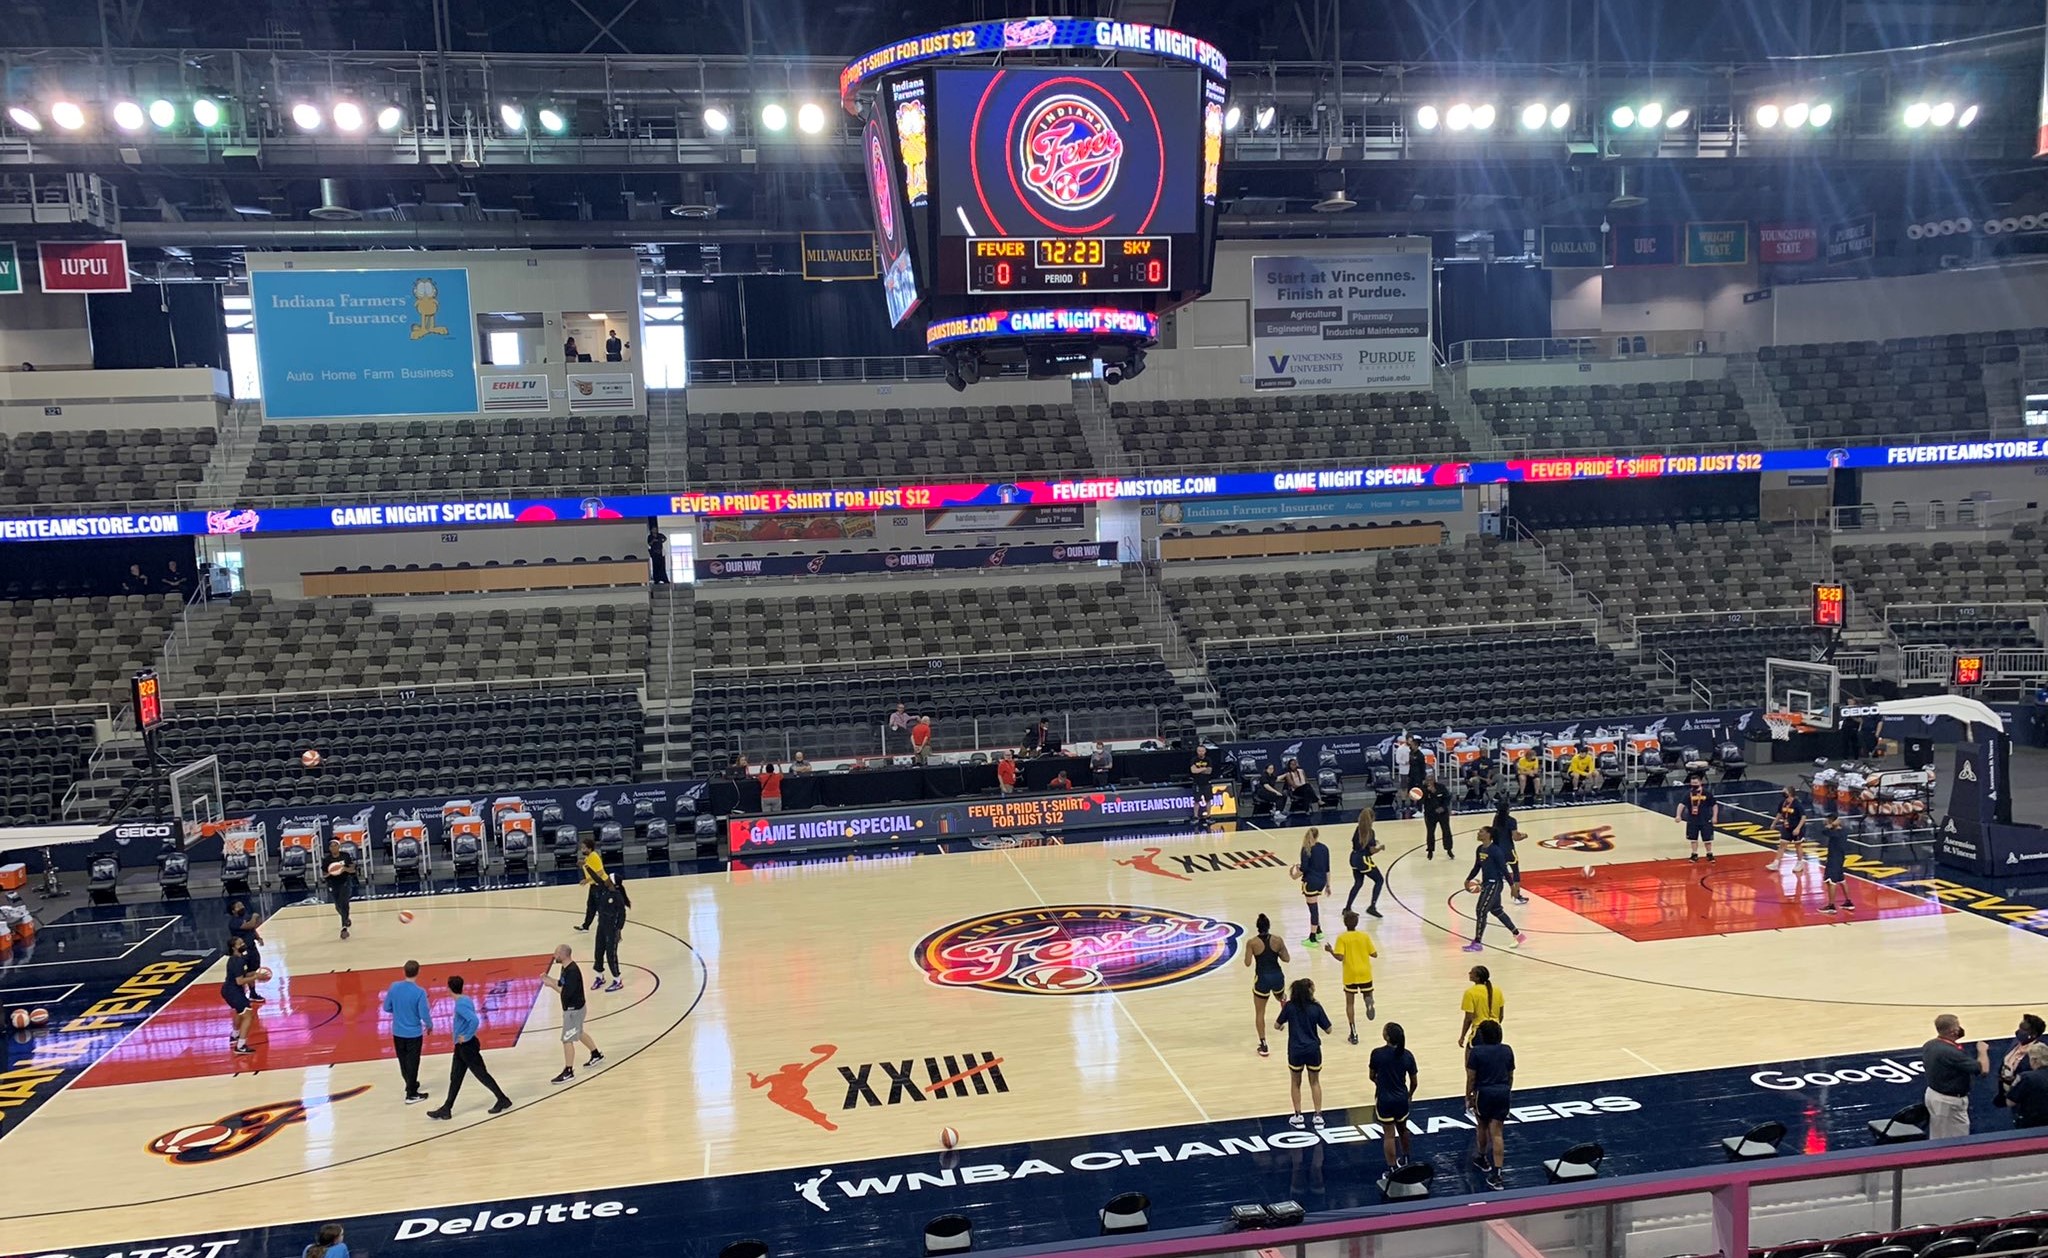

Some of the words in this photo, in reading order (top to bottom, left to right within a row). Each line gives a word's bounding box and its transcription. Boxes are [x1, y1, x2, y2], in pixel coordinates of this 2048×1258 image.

[1096, 21, 1152, 50] GAME
[1153, 27, 1199, 61] NIGHT
[863, 46, 896, 73] T-SHIRT
[897, 41, 920, 61] FOR
[920, 33, 952, 56] JUST
[892, 78, 924, 94] Indiana
[1040, 106, 1103, 132] INDIANA
[1028, 122, 1123, 187] Fever
[1760, 229, 1817, 241] YOUNGSTOWN
[977, 241, 1025, 257] FEVER
[1123, 241, 1151, 255] SKY
[1551, 241, 1597, 253] OAKLAND
[1776, 242, 1802, 254] STATE
[806, 249, 873, 262] MILWAUKEE
[60, 258, 109, 275] IUPUI
[1148, 261, 1161, 282] 0
[997, 263, 1012, 285] 0
[1045, 274, 1073, 284] PERIOD
[1267, 272, 1306, 284] Start
[1310, 272, 1326, 283] at
[1331, 270, 1416, 283] Vincennes.
[1277, 287, 1323, 300] Finish
[1328, 287, 1344, 299] at
[1348, 286, 1406, 299] Purdue.
[272, 295, 336, 309] Indiana
[339, 293, 407, 309] Farmers
[328, 311, 407, 326] Insurance
[1011, 312, 1055, 331] GAME
[1057, 311, 1102, 329] NIGHT
[1104, 312, 1147, 331] SPECIAL
[1290, 310, 1337, 321] Agriculture
[1352, 312, 1393, 323] Pharmacy
[1267, 323, 1318, 334] Engineering
[1326, 326, 1366, 336] Industrial
[1367, 325, 1419, 335] Maintenance
[1291, 352, 1343, 363] VINCENNES
[1359, 350, 1416, 364] PURDUE
[286, 369, 314, 382] Auto
[322, 369, 357, 381] Home
[364, 368, 395, 381] Farm
[401, 366, 454, 379] Business
[1290, 363, 1344, 373] UNIVERSITY
[1366, 374, 1411, 383] purdue.edu
[1531, 462, 1571, 478] FEVER
[1574, 460, 1613, 477] PRIDE
[1615, 458, 1666, 476] T-SHIRT
[1668, 457, 1697, 473] FOR
[1699, 455, 1735, 472] JUST
[1736, 454, 1762, 471] $12
[1274, 472, 1317, 491] GAME
[1318, 470, 1363, 489] NIGHT
[1365, 467, 1425, 486] SPECIAL
[1052, 477, 1217, 500] FEVERTEAMSTORE.COM
[671, 495, 720, 513] FEVER
[724, 493, 769, 511] PRIDE
[772, 492, 832, 510] T-SHIRT
[835, 491, 866, 508] FOR
[867, 489, 903, 506] JUST
[905, 489, 931, 506] $12
[1187, 507, 1230, 517] Indiana
[1232, 505, 1278, 515] Farmers
[1280, 502, 1334, 513] Insurance
[1345, 501, 1363, 510] Auto
[1370, 499, 1393, 508] Home
[1400, 498, 1420, 507] Farm
[331, 508, 383, 526] GAME
[386, 504, 439, 524] NIGHT
[442, 502, 514, 522] SPECIAL
[1142, 508, 1155, 516] 201
[893, 517, 908, 527] 200
[900, 555, 917, 565] OUR
[917, 553, 935, 564] WAY
[1067, 547, 1083, 558] OUR
[1083, 546, 1101, 556] WAY
[725, 562, 743, 573] OUR
[744, 560, 762, 571] WAY
[1728, 614, 1742, 623] 102
[1820, 601, 1839, 622] 24
[1396, 633, 1410, 643] 101
[927, 659, 943, 669] 100
[1960, 669, 1976, 682] 24
[400, 690, 415, 700] 117
[1841, 706, 1880, 718] GEICO
[633, 789, 666, 797] Ascension
[968, 803, 1004, 818] FEVER
[1006, 802, 1040, 815] PRIDE
[1042, 798, 1084, 813] T-SHIRT
[992, 814, 1016, 828] FOR
[1017, 813, 1044, 826] JUST
[1045, 811, 1064, 825] $12
[115, 826, 171, 839] GEICO
[750, 825, 796, 843] GAME
[799, 820, 847, 839] NIGHT
[851, 816, 915, 836] SPECIAL
[1943, 836, 1976, 851] Ascension
[1952, 848, 1977, 860] Vincent
[1897, 877, 2048, 931] FEVE
[957, 910, 1152, 942] INDIANA
[936, 917, 1238, 985] Fever
[60, 958, 203, 1033] FEVER
[837, 1157, 1065, 1198] WNBA
[1070, 1096, 1643, 1172] CHANGEMAERS
[394, 1201, 639, 1241] Deloitte.
